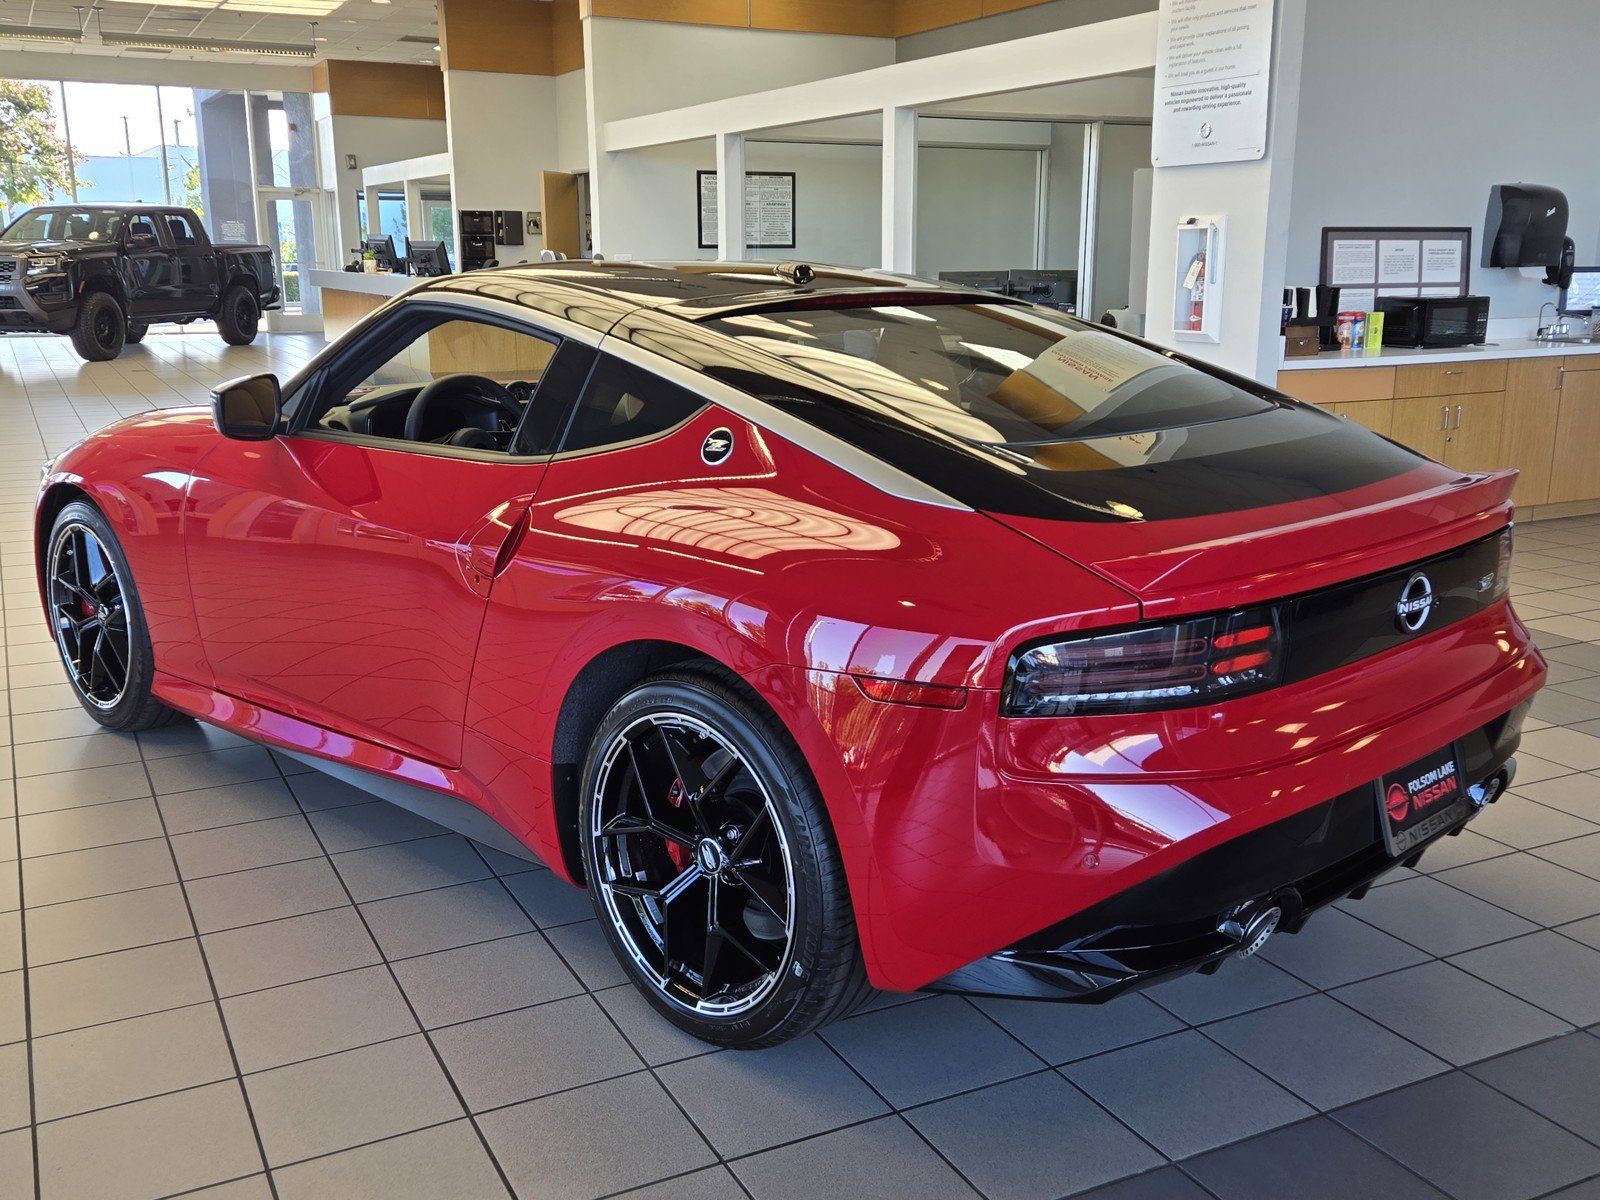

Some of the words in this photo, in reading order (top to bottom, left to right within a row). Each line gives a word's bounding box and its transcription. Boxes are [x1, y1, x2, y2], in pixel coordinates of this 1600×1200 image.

[1180, 96, 1203, 104] engineered
[1228, 90, 1252, 98] passionate
[1220, 82, 1247, 91] high-quality
[1408, 771, 1438, 794] FOLSOM
[1438, 761, 1456, 780] LAKE
[1412, 775, 1458, 810] NISSAN
[1408, 813, 1453, 842] NISSAN
